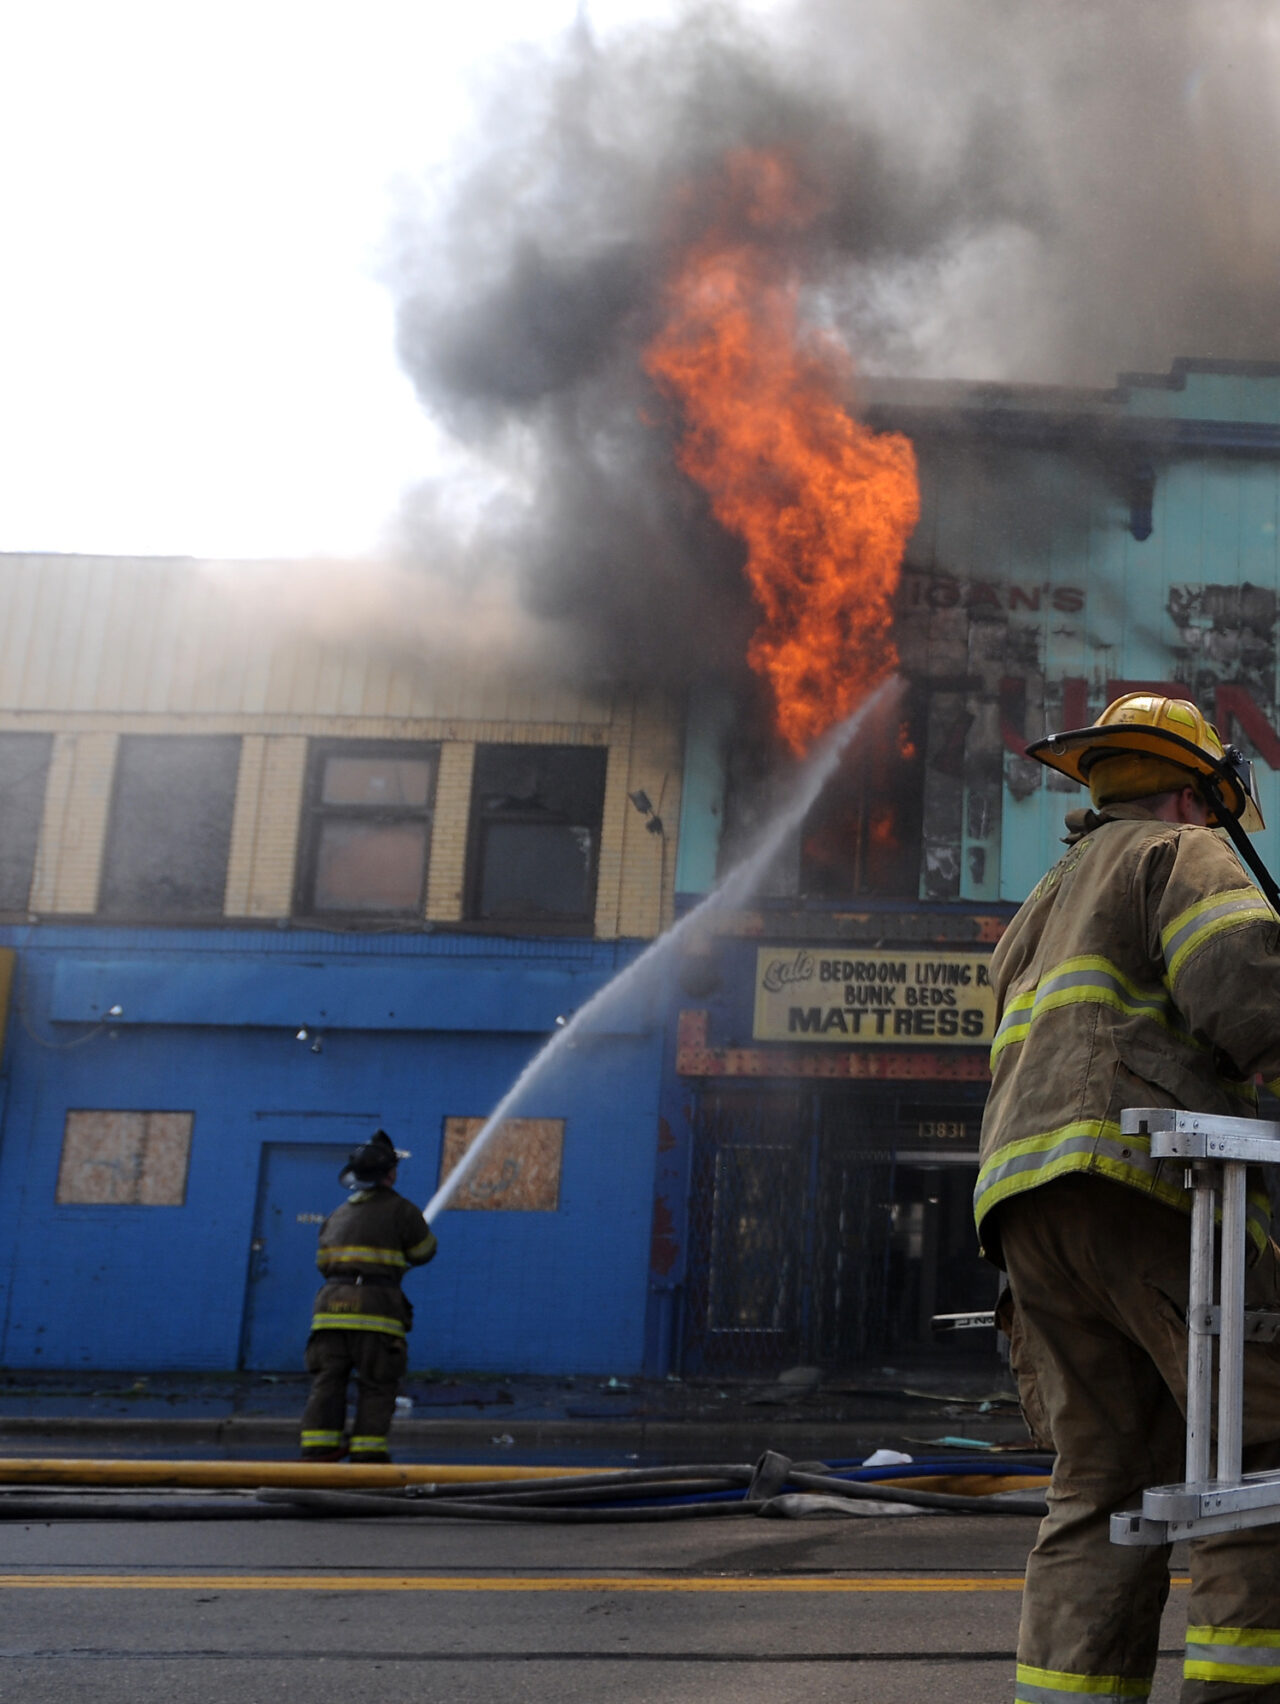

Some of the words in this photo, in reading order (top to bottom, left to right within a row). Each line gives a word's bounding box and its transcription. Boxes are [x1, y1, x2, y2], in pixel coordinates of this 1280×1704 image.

[763, 951, 816, 992] Sale
[819, 959, 907, 984] BEDROOM
[915, 963, 972, 987] LIVING
[844, 985, 896, 1006] BUNK
[904, 988, 957, 1007] BEDS
[788, 1006, 985, 1037] MATTRESS
[918, 1121, 967, 1138] 13831
